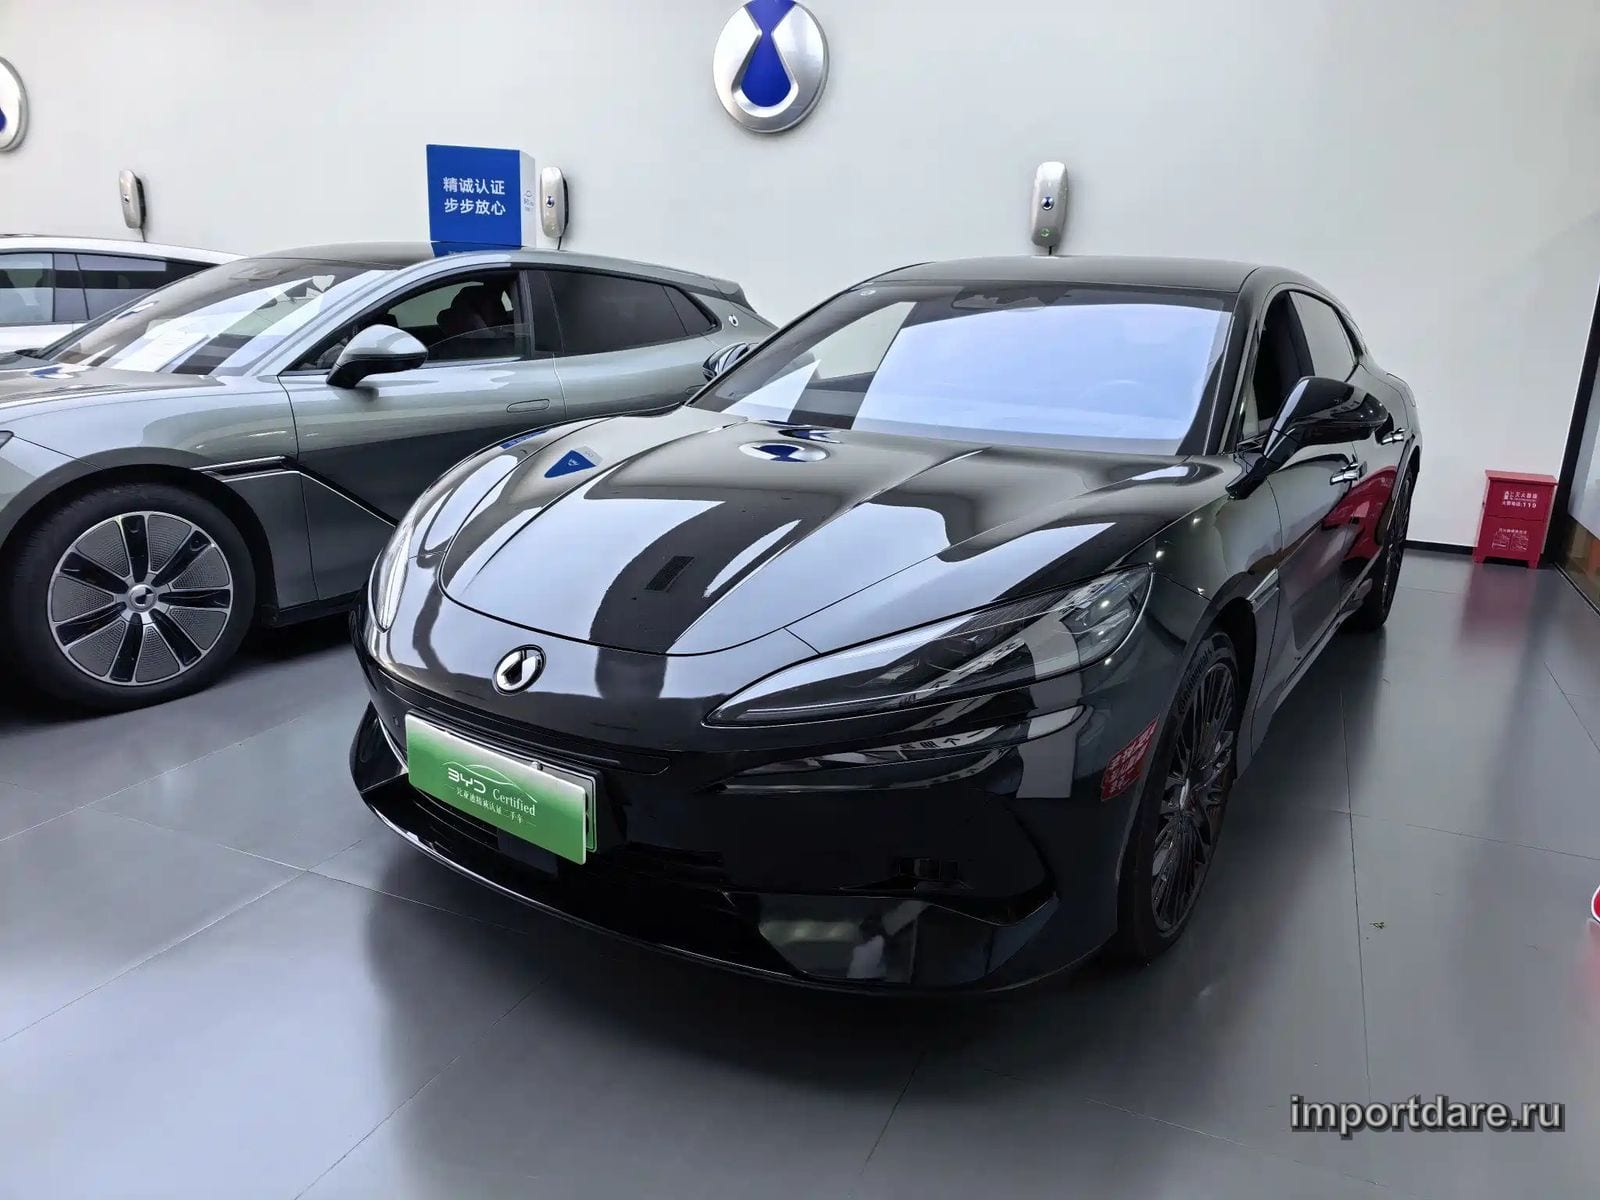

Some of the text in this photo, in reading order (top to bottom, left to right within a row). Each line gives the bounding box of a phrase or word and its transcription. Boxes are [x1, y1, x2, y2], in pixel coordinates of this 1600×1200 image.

[443, 177, 506, 195] 精诚认证
[444, 198, 507, 216] 步步放心
[447, 767, 536, 817] BYD Certified
